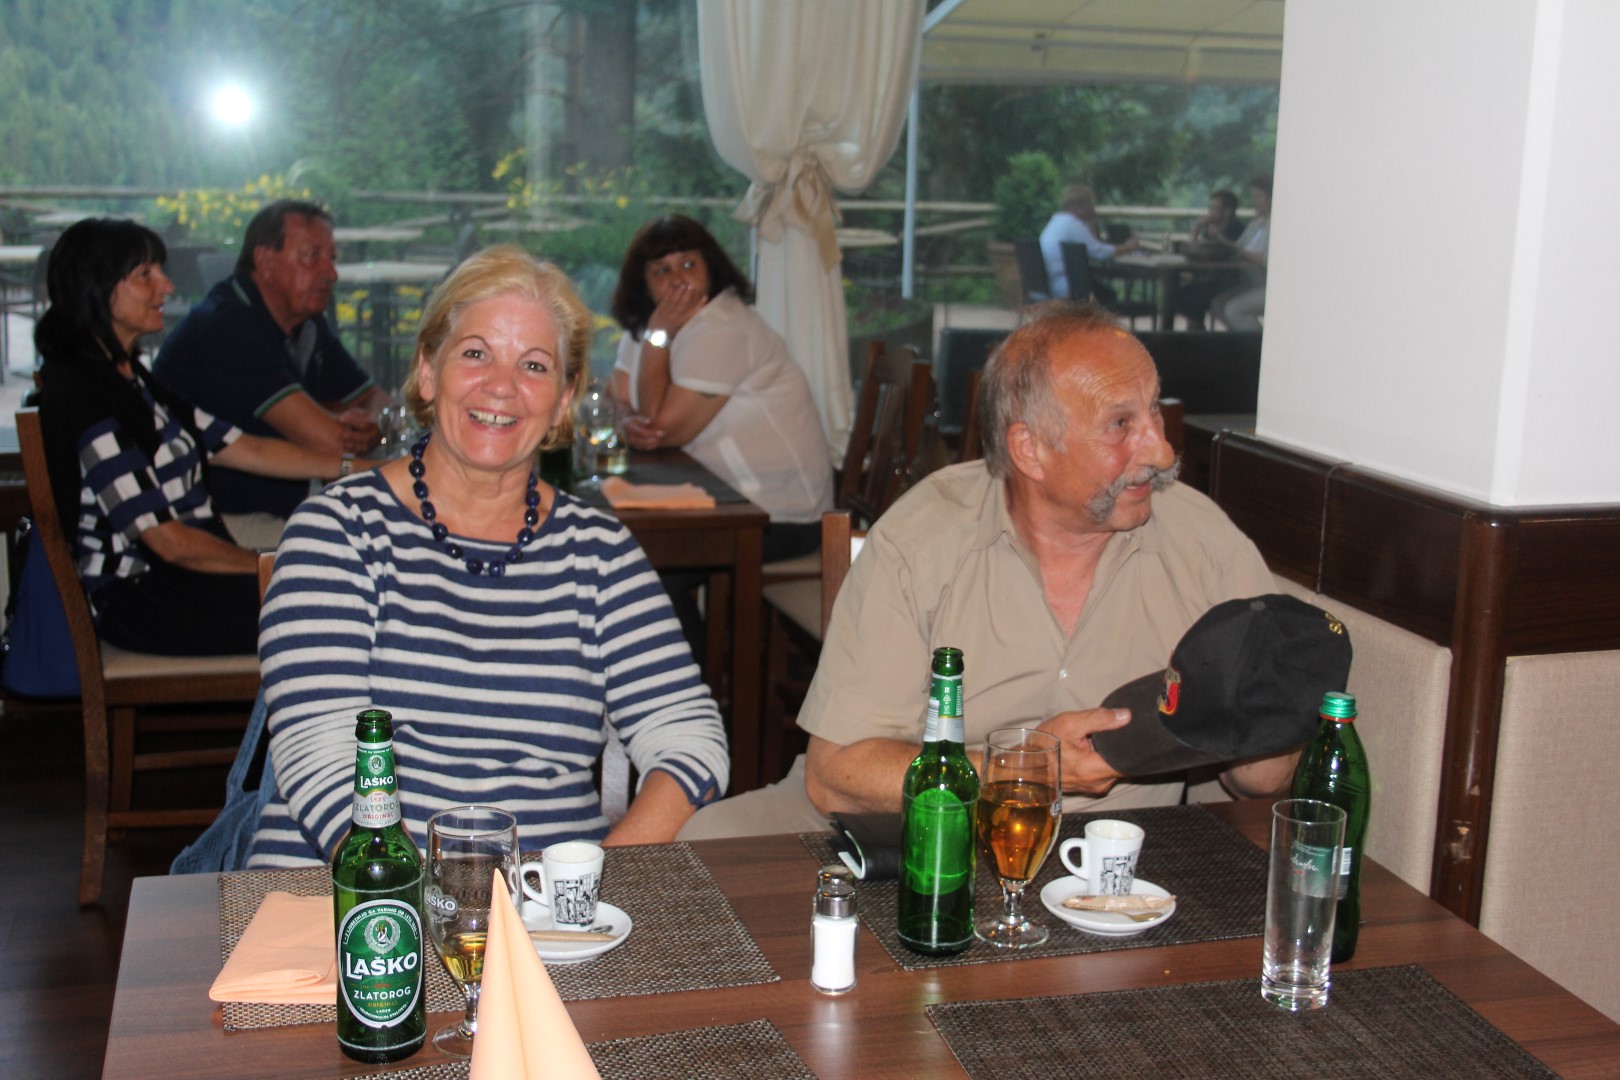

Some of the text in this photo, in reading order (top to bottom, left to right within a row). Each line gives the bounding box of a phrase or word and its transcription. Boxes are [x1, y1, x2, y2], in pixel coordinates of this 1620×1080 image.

[355, 801, 399, 812] ZLATOROG
[346, 951, 418, 980] LAŠKO
[354, 986, 411, 1000] ZLATOROG
